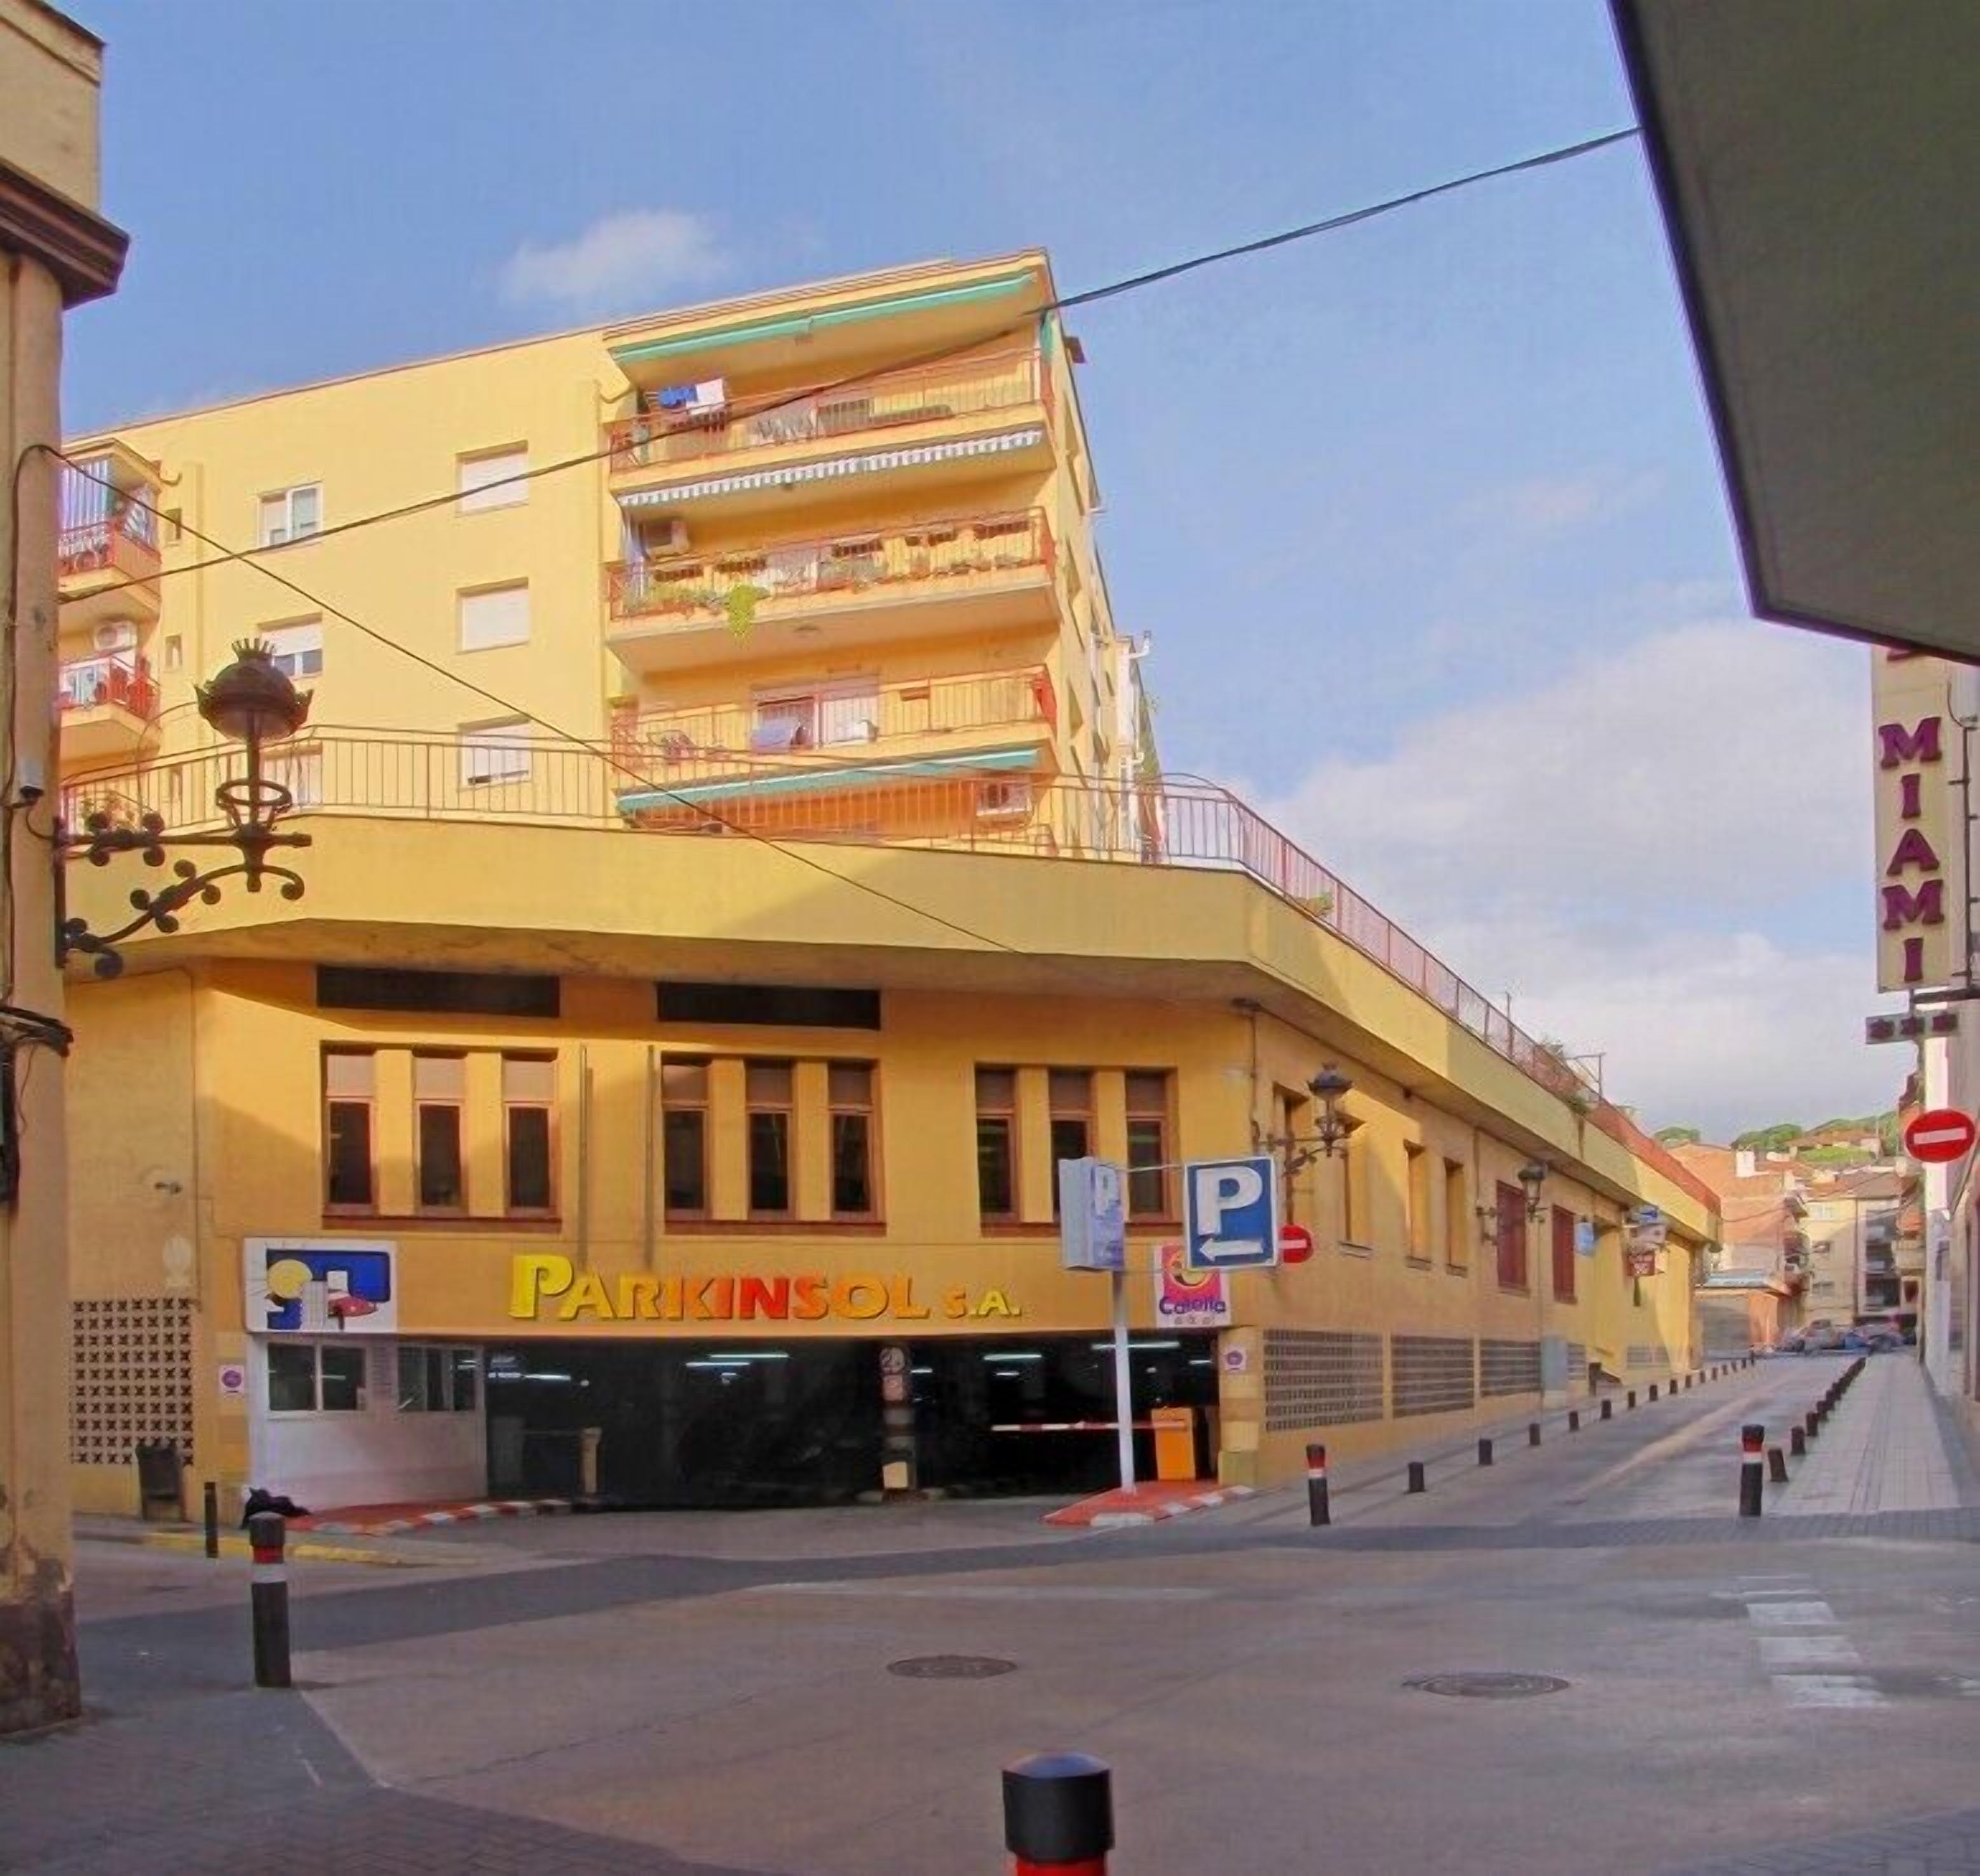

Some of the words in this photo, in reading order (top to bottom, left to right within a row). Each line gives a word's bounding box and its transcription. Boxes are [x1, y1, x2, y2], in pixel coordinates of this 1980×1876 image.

[1878, 716, 1944, 982] MIAMI
[1196, 1166, 1263, 1235] P
[508, 1254, 930, 1320] PARKINSOL
